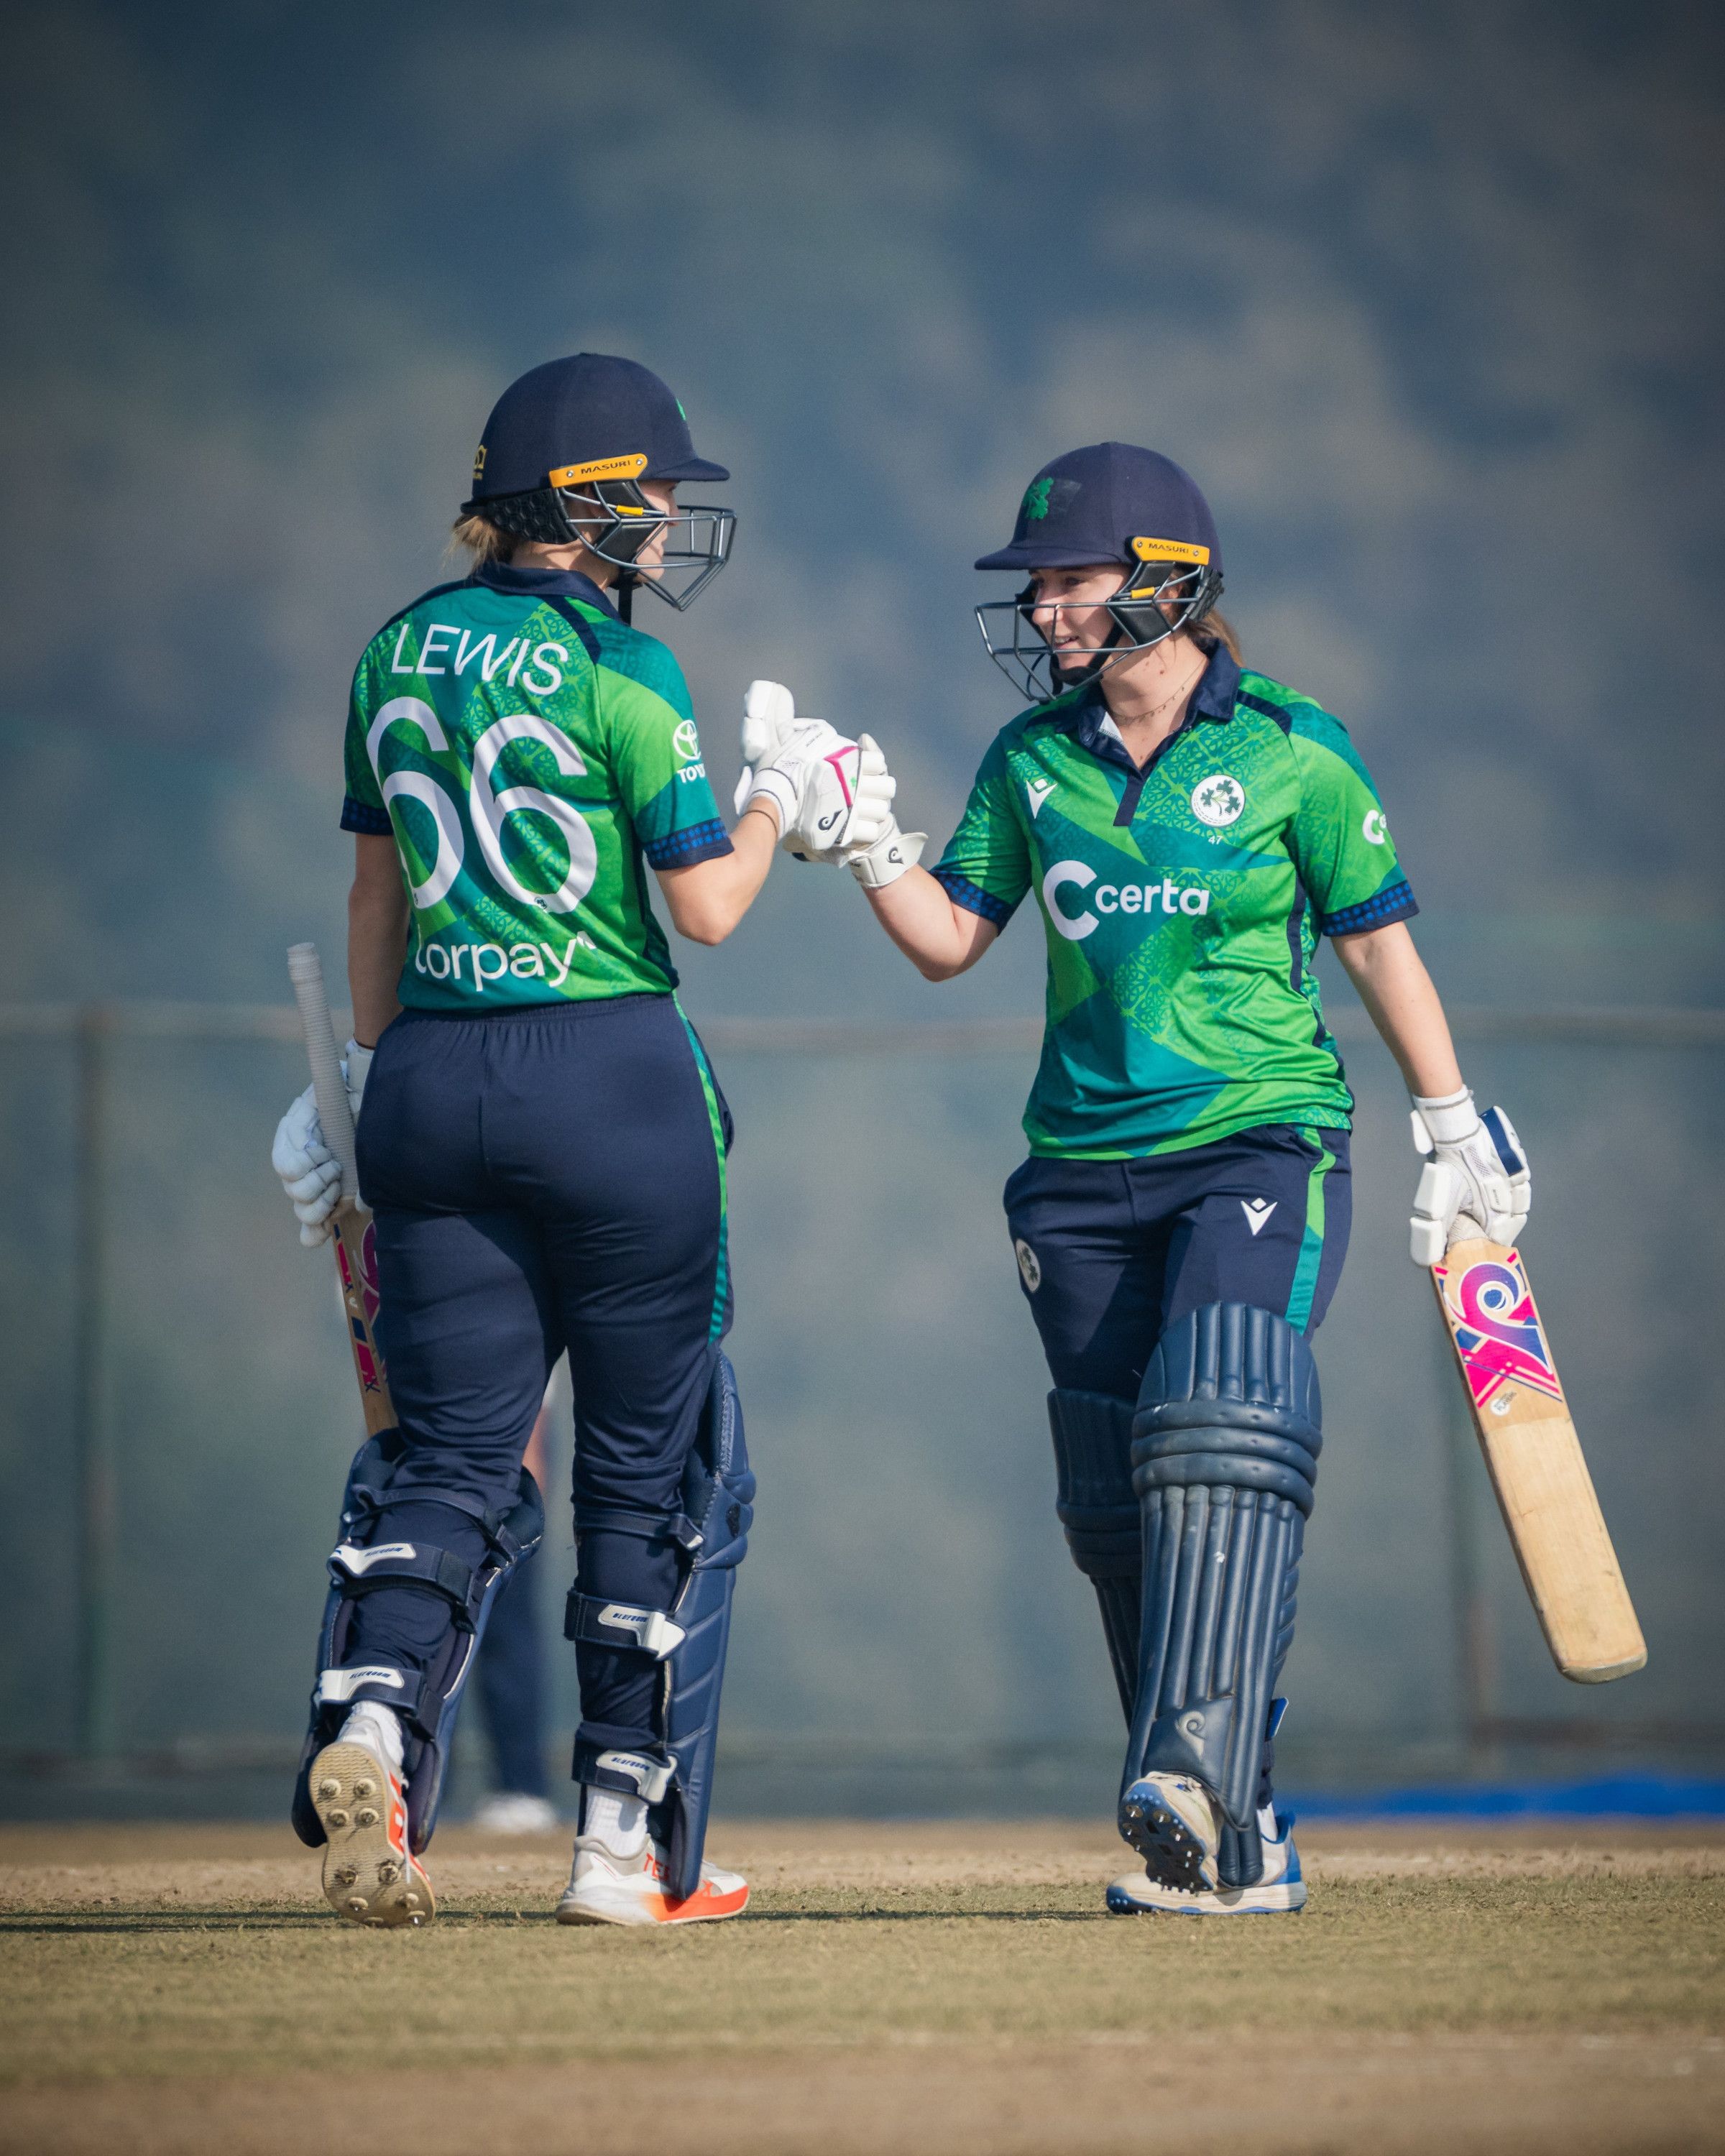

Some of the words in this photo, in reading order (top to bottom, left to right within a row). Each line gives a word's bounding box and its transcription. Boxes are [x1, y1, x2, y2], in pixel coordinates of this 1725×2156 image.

[580, 460, 630, 474] MASURI
[1149, 543, 1189, 553] MASURI
[391, 623, 569, 696] LEWIS
[366, 696, 597, 914] 66
[1208, 835, 1223, 845] 47
[1095, 878, 1210, 916] certa
